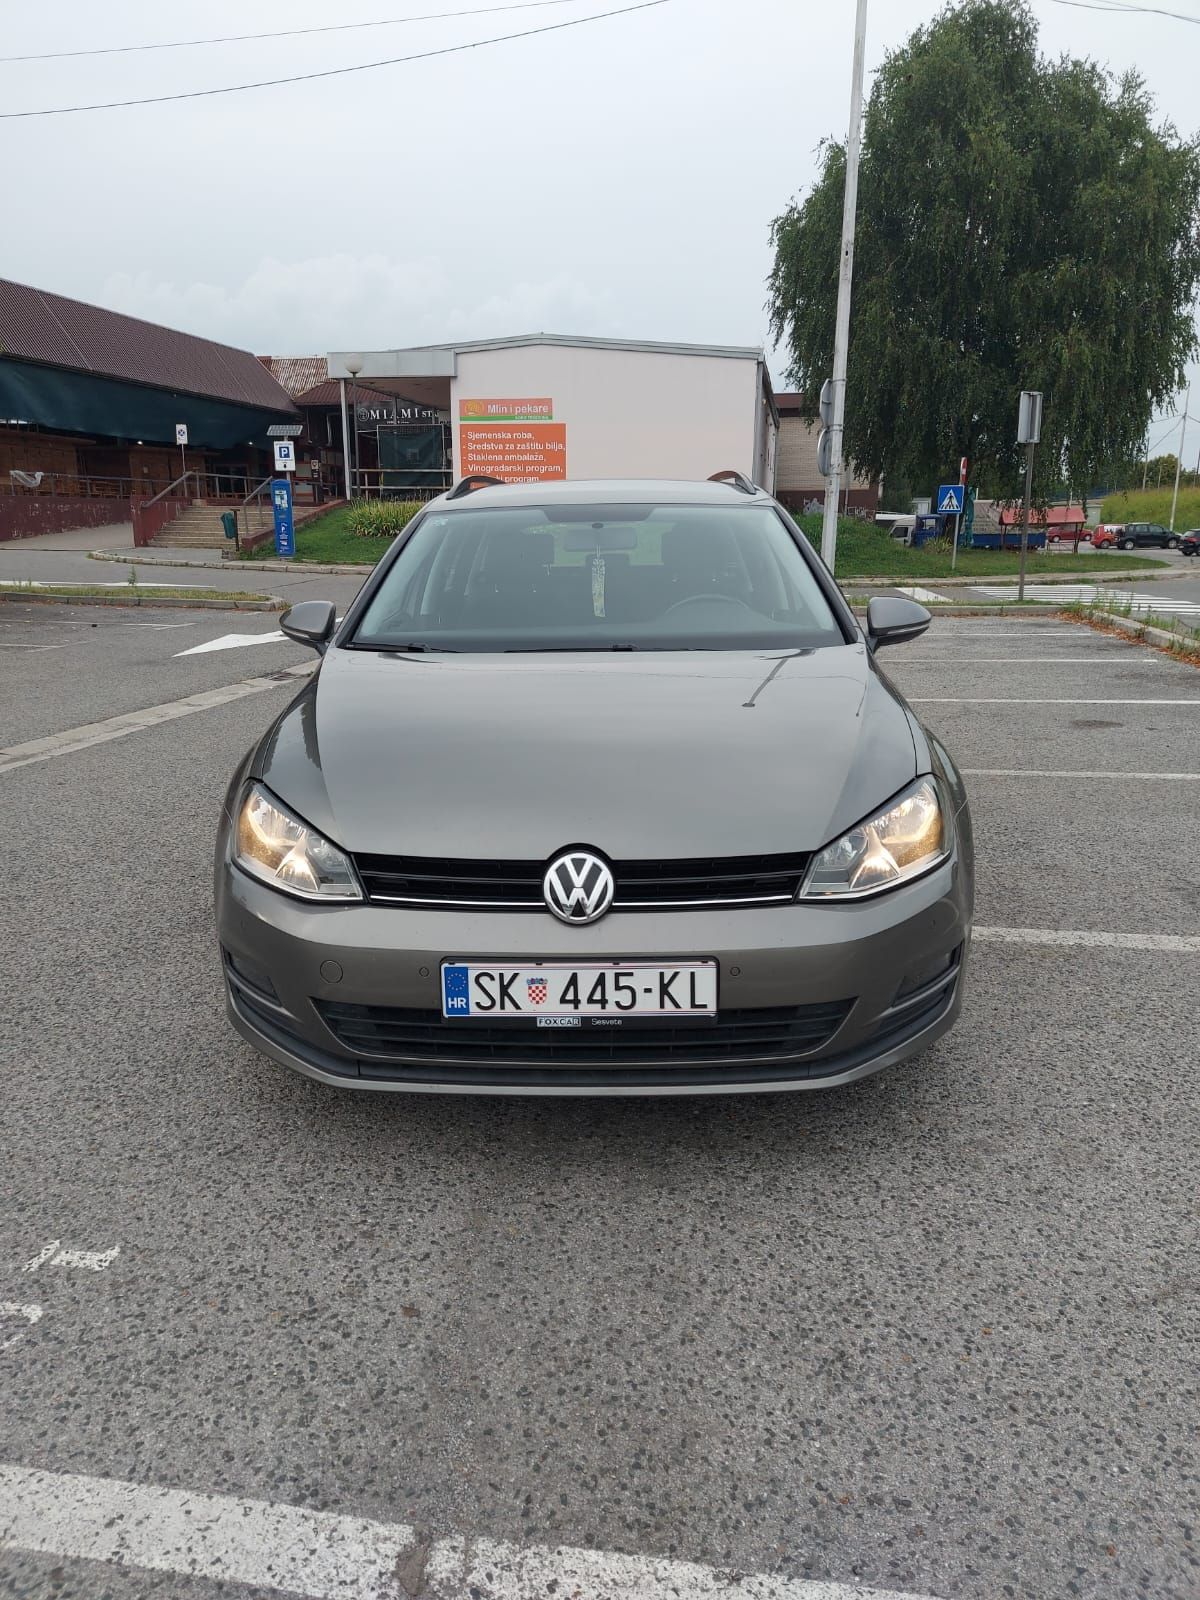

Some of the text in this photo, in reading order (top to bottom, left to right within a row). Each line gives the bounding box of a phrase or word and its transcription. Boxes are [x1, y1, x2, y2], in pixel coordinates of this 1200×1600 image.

[487, 404, 507, 414] Mlin
[515, 404, 549, 416] pekare
[467, 432, 512, 441] Sjemenska
[467, 442, 504, 451] Sredstva
[517, 442, 544, 450] zaštitu
[467, 453, 504, 461] Staklena
[467, 464, 524, 474] Vinogradarski
[473, 970, 709, 1012] SK 445-KL
[447, 996, 468, 1009] HR
[538, 1018, 623, 1026] FOXCAR Sesvete
